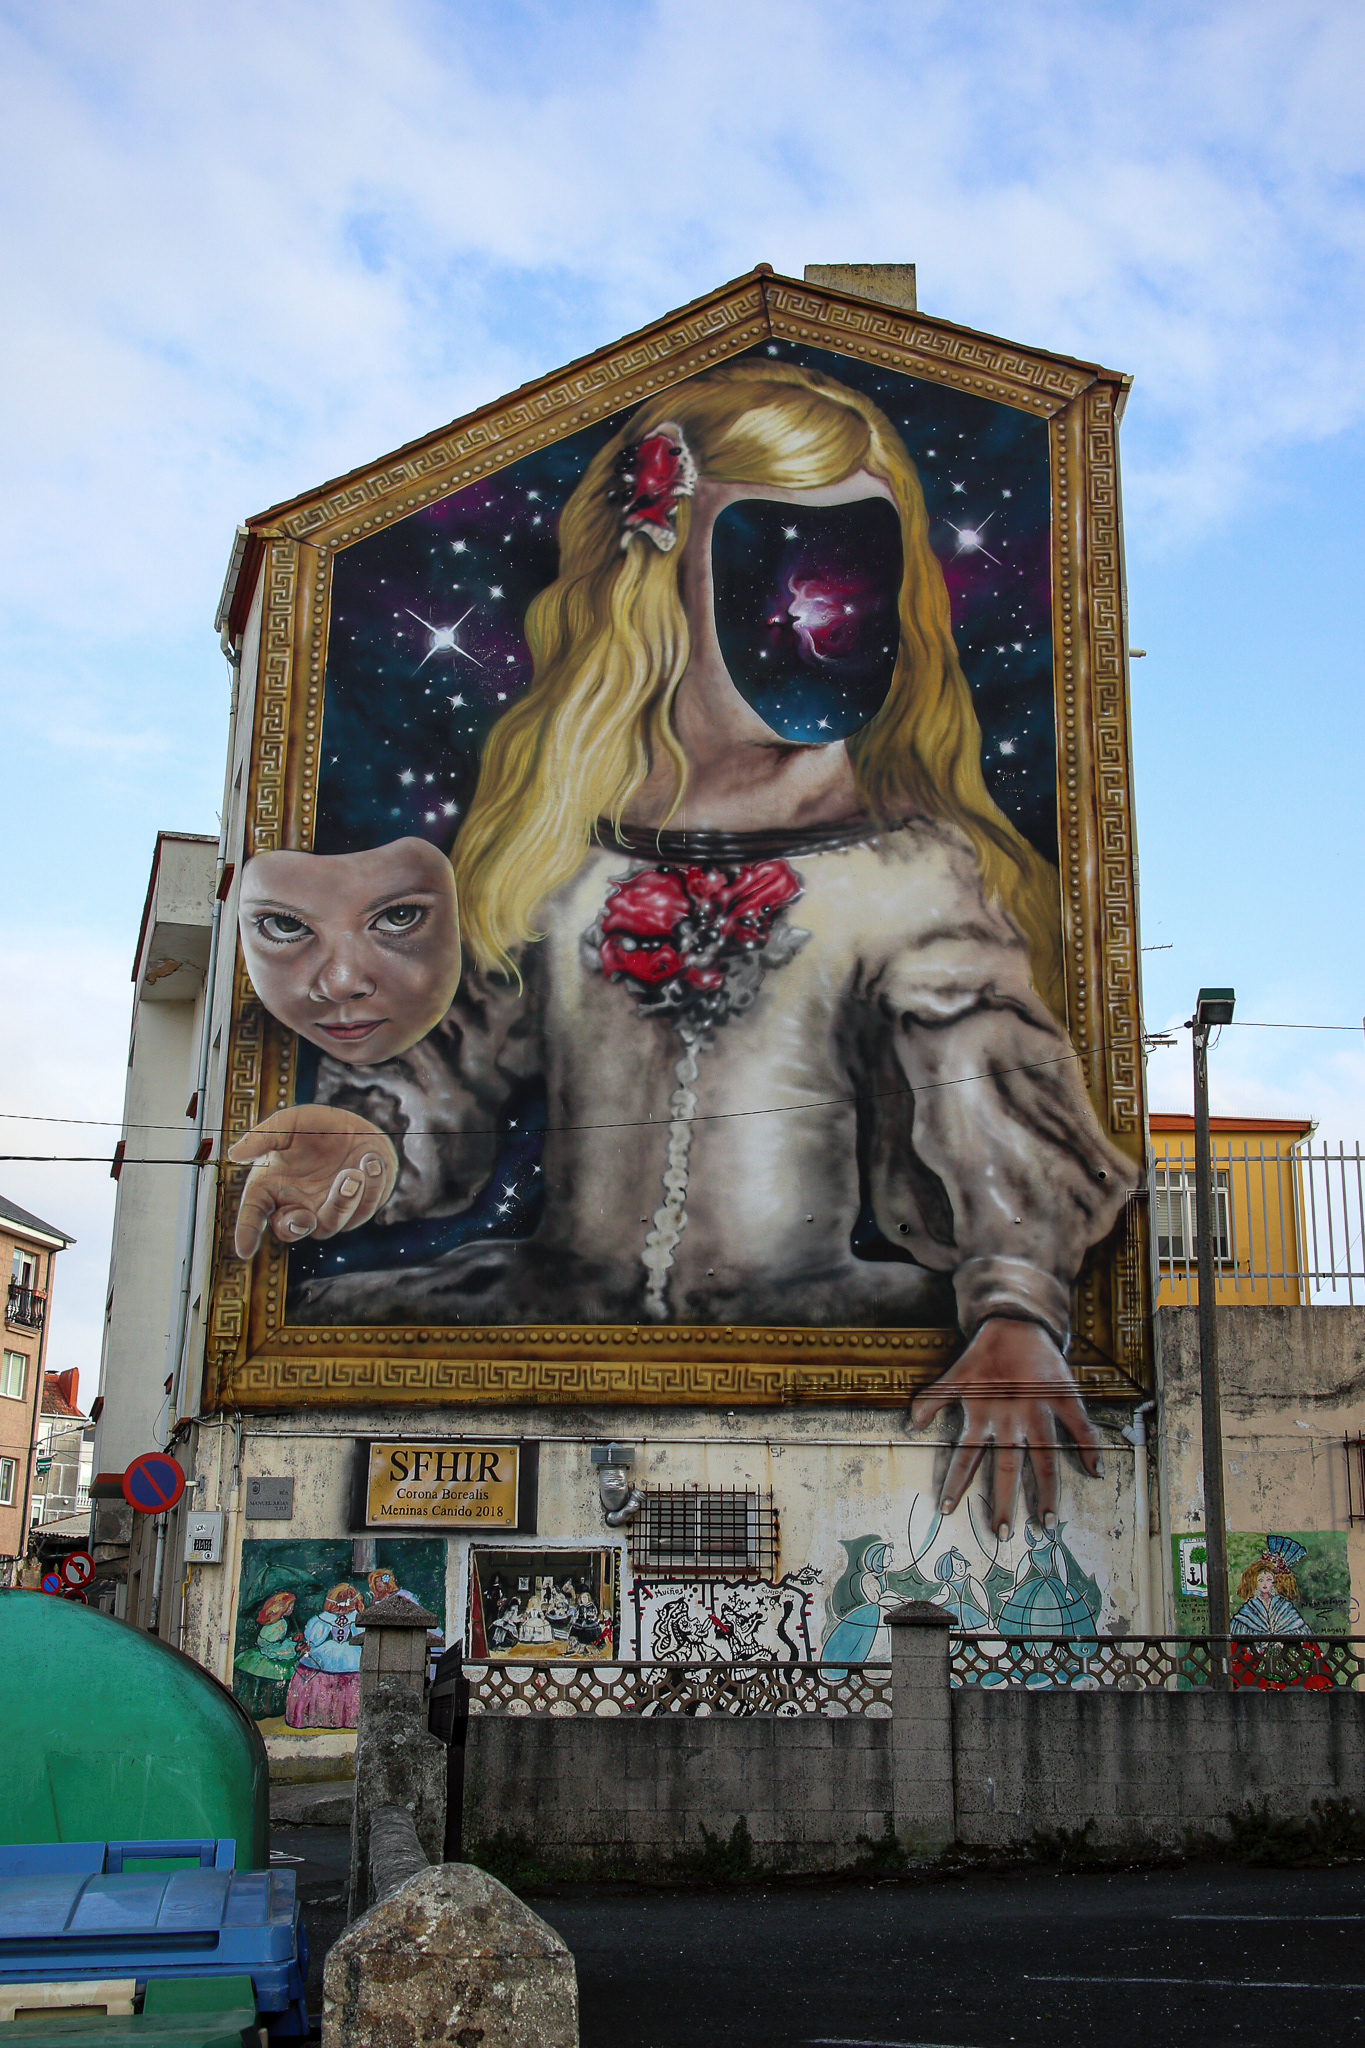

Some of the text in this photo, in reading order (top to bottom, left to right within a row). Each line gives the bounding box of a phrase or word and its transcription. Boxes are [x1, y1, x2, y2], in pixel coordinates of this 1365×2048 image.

[390, 1450, 502, 1483] SFHIR
[397, 1488, 489, 1500] Corona Borealis
[380, 1504, 428, 1516] Meninas
[475, 1506, 504, 1517] 2018
[654, 1587, 684, 1598] Muiños
